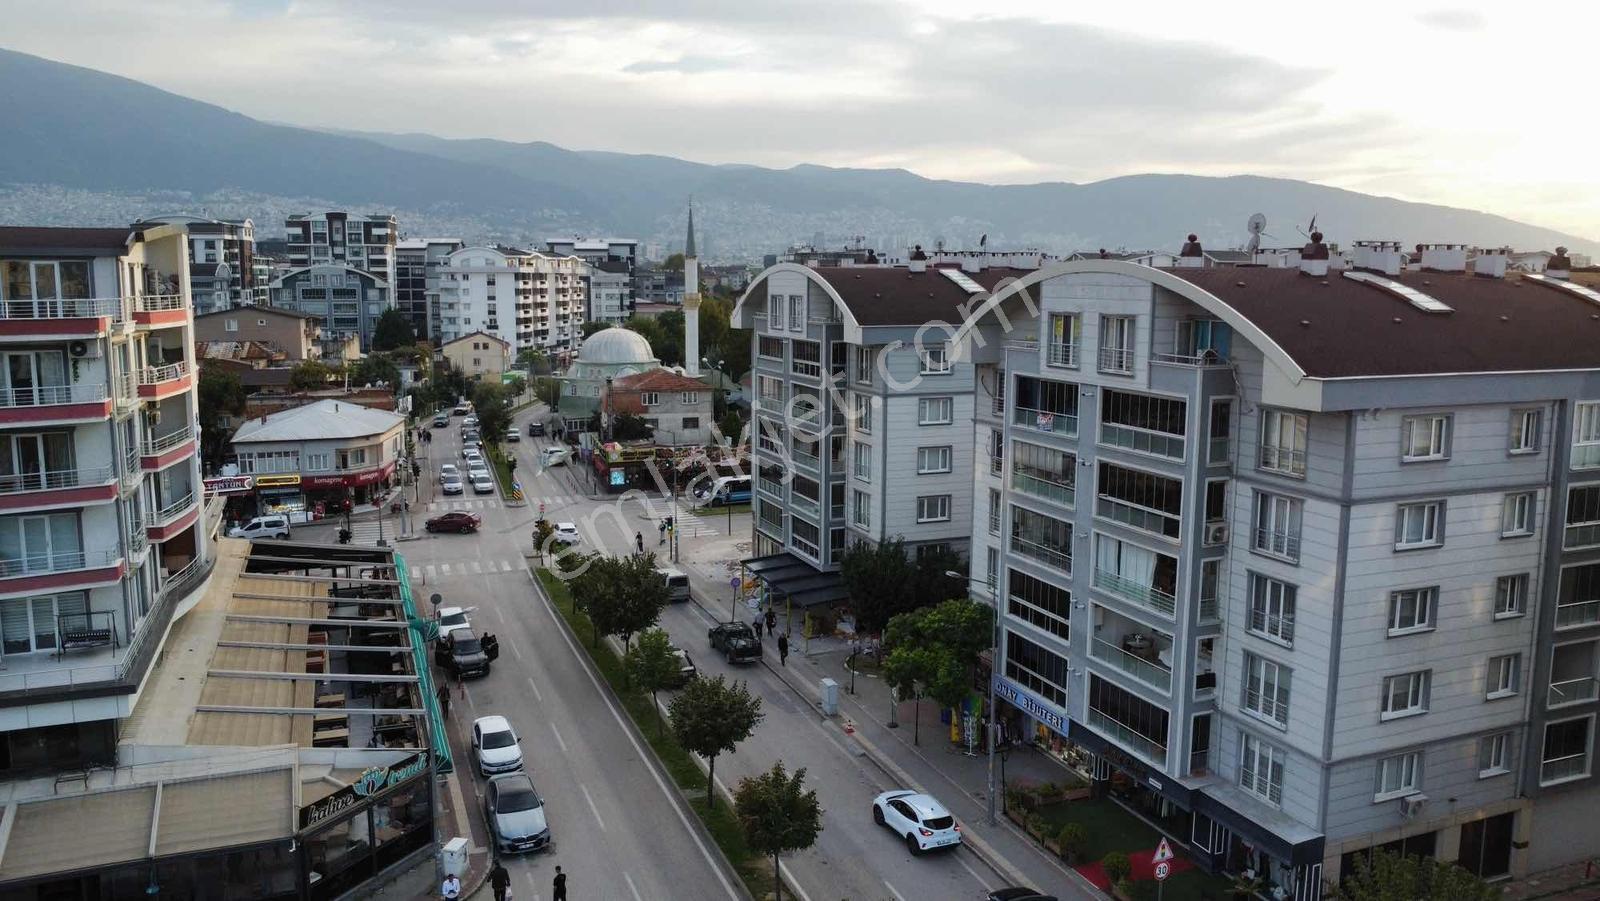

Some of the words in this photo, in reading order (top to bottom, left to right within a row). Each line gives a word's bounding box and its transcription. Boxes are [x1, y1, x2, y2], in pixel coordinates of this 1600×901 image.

[997, 681, 1018, 702] ONAY
[308, 793, 355, 825] kahve
[1156, 865, 1167, 875] 30
